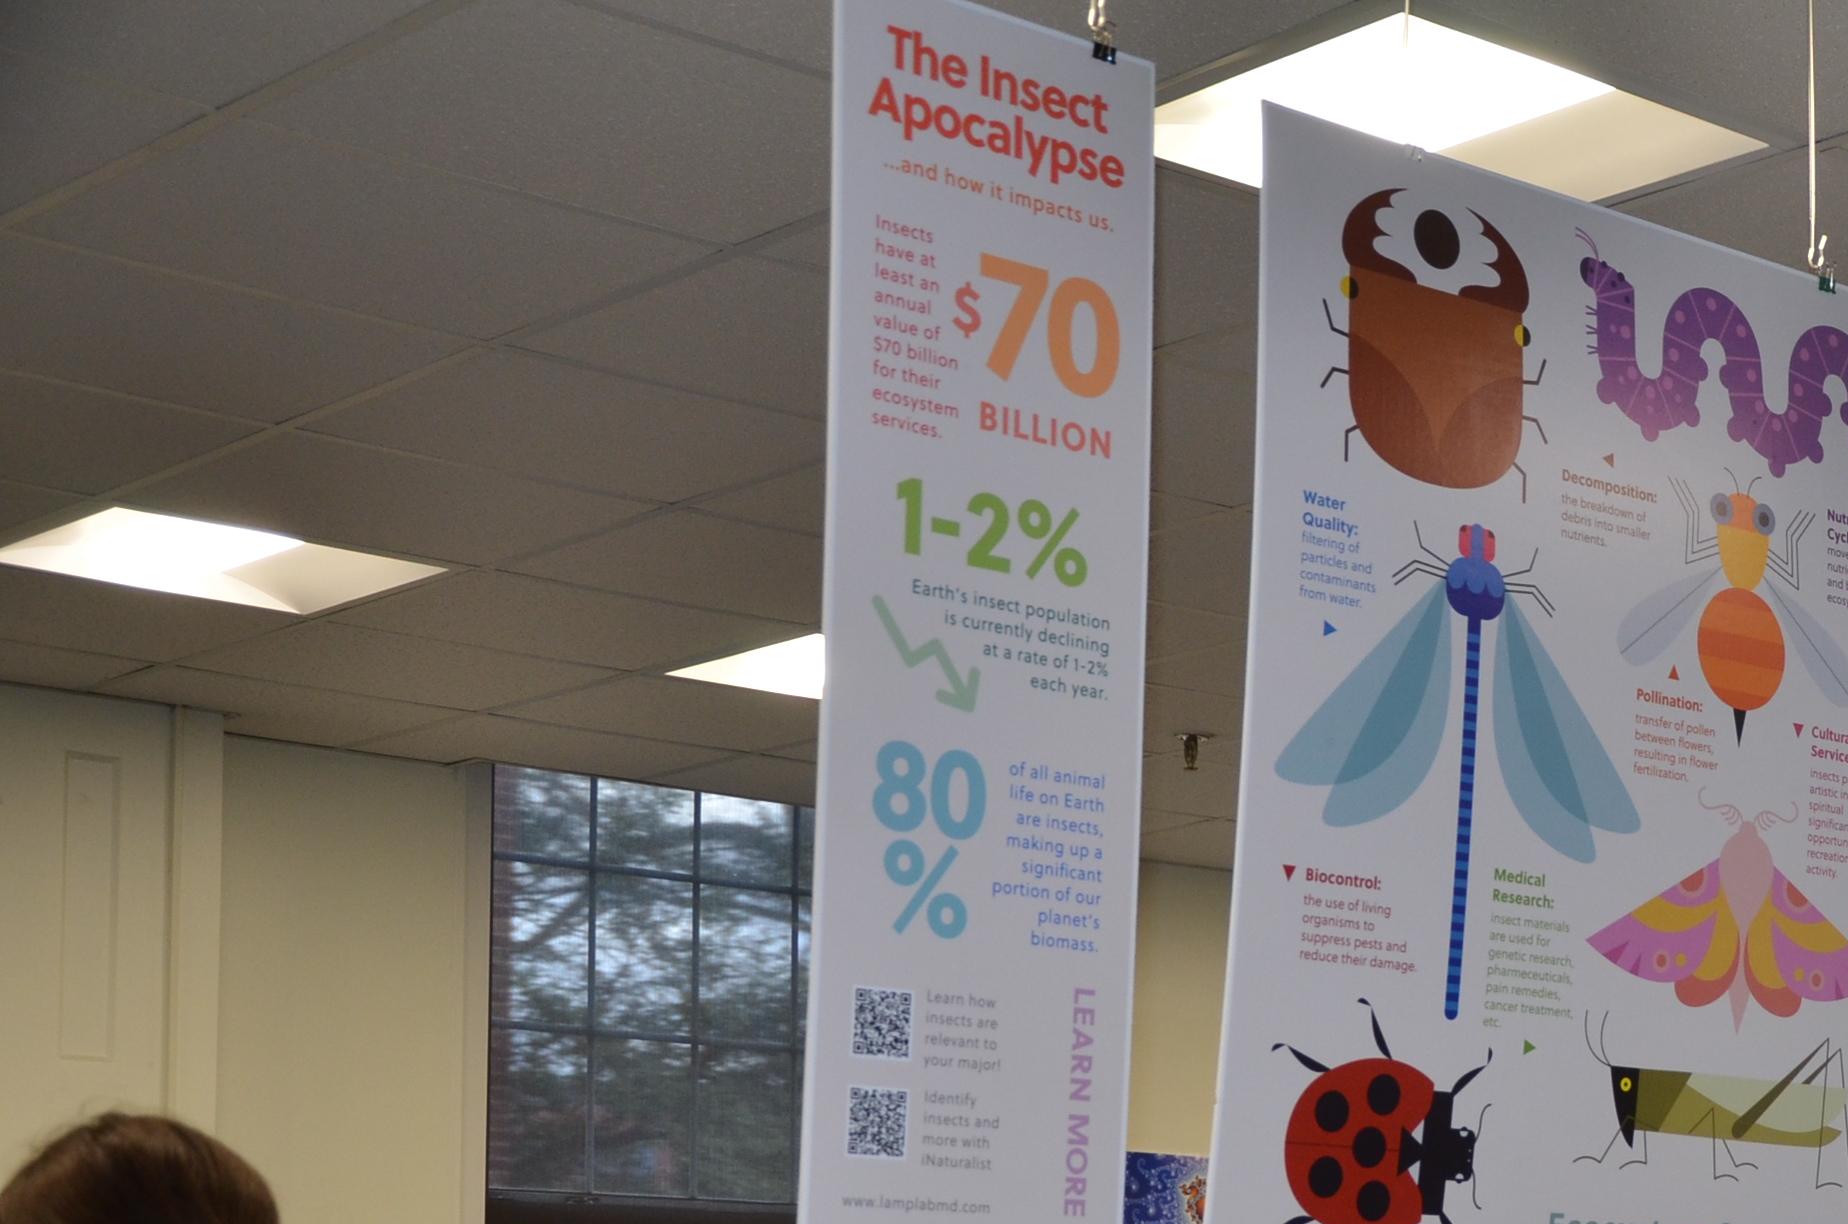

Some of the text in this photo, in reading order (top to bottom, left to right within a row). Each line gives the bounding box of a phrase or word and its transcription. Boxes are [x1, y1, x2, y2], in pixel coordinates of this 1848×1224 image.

[887, 25, 1108, 134] The Insect
[869, 77, 1124, 188] Apocalypse
[944, 167, 984, 194] how
[990, 182, 1003, 200] it
[1009, 187, 1082, 223] impacts
[1088, 214, 1114, 232] us.
[876, 214, 933, 244] Insects
[875, 238, 936, 268] have at
[875, 262, 940, 293] least an
[874, 291, 931, 315] annual
[873, 315, 941, 341] value of
[952, 252, 1120, 399] $70
[874, 335, 958, 370] $70 billion
[873, 359, 940, 389] for their
[872, 388, 958, 418] ecosystem
[872, 412, 942, 438] services.
[980, 401, 1111, 459] BILLION
[1562, 468, 1656, 503] Decomposition:
[1303, 490, 1346, 511] Water
[1562, 493, 1646, 522] the breakdown of
[896, 477, 1089, 588] 1-2%
[1302, 512, 1358, 538] Quality:
[1560, 510, 1651, 540] debris into smaller
[1302, 530, 1360, 554] filtering of
[1300, 552, 1372, 574] particles and
[1299, 570, 1376, 593] contaminants
[1827, 578, 1843, 590] and
[912, 578, 1110, 630] Earth's insect population
[1299, 584, 1362, 608] from water.
[944, 609, 1109, 658] is currently declining
[982, 644, 1108, 677] at a rate of 1-2%
[1030, 676, 1108, 700] each year.
[1636, 688, 1703, 712] Pollination:
[1635, 714, 1716, 737] transfer of pollen
[1634, 728, 1714, 755] between flowers,
[1634, 748, 1718, 770] resulting in flower
[1008, 761, 1105, 789] of all animal
[1810, 768, 1840, 783] insects
[872, 740, 987, 841] 80
[1009, 784, 1104, 812] life on Earth
[1809, 786, 1838, 799] artistic
[1808, 801, 1844, 815] spiritual
[1016, 813, 1103, 838] are insects,
[1006, 835, 1102, 861] making up a
[1022, 859, 1102, 883] significant
[1306, 867, 1381, 890] Biocontrol:
[883, 839, 968, 940] %
[992, 881, 1101, 905] portion of our
[1303, 893, 1392, 919] the use of living
[1038, 908, 1100, 930] planet's
[1302, 914, 1375, 932] organisms to
[1030, 930, 1098, 952] biomass.
[1301, 932, 1407, 953] suppress pests and
[1300, 949, 1338, 963] reduce
[1341, 952, 1367, 966] their
[926, 989, 996, 1008] Learn how
[925, 1013, 999, 1030] insects are
[924, 1033, 997, 1051] relevant to
[923, 1056, 1000, 1073] your major!
[924, 1090, 976, 1110] Identify
[1064, 988, 1097, 1218] LEARN MORE
[923, 1112, 1000, 1129] insects and
[922, 1135, 990, 1149] more with
[921, 1153, 992, 1170] iNaturalist
[842, 1195, 990, 1214] www.lamplabmd.com
